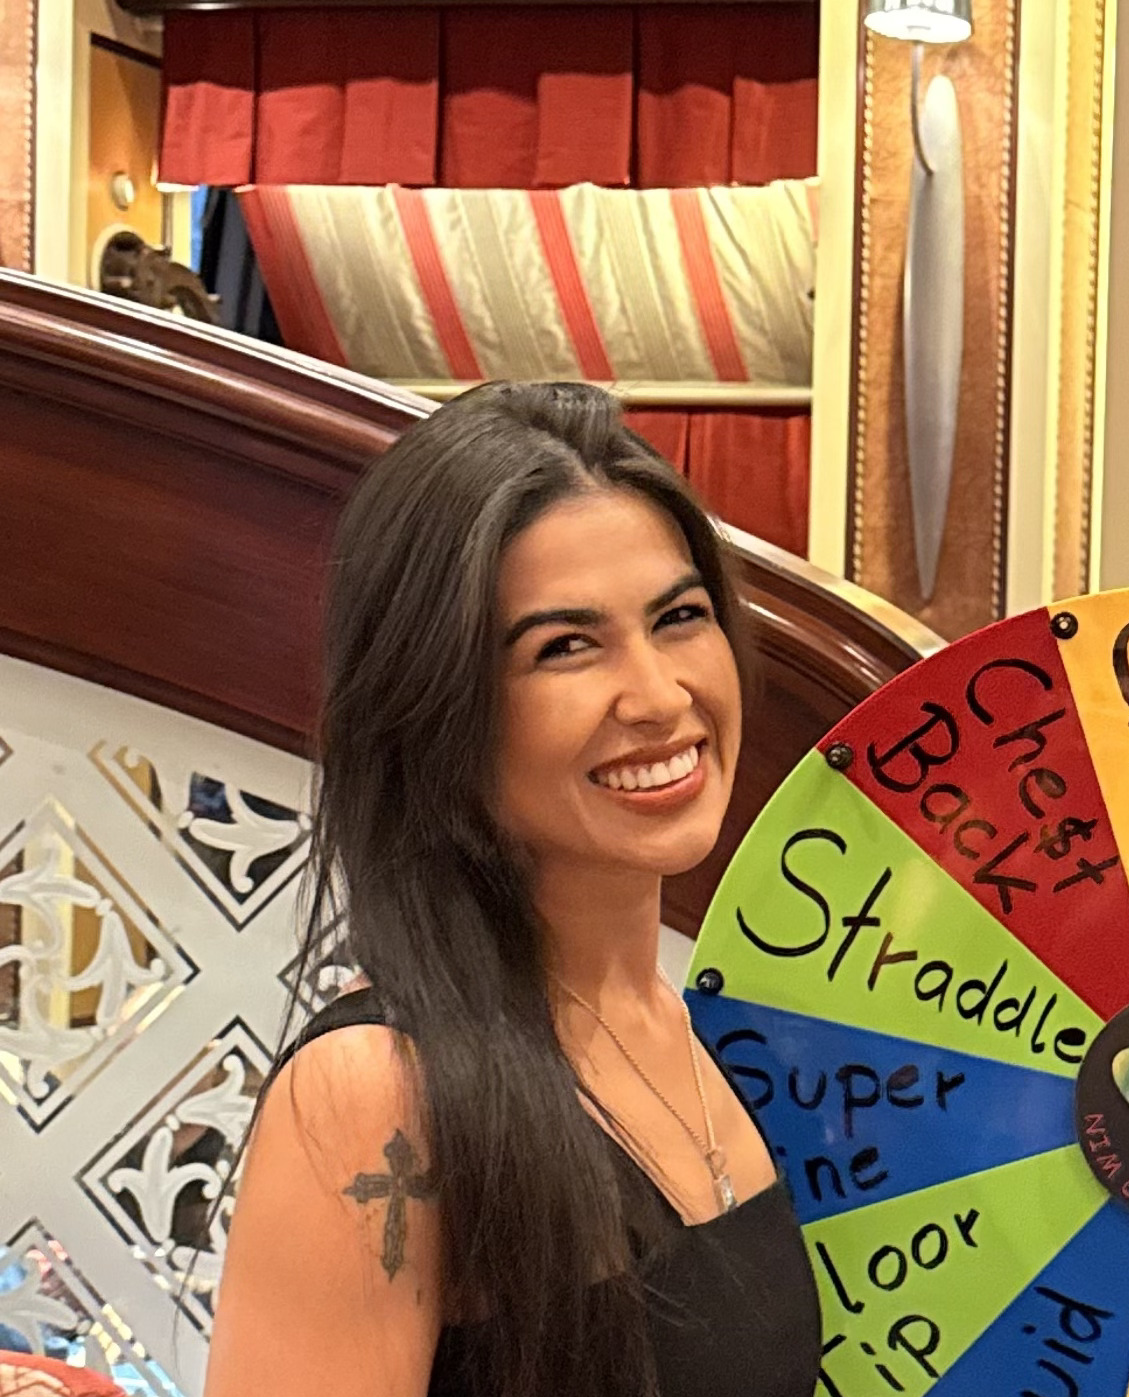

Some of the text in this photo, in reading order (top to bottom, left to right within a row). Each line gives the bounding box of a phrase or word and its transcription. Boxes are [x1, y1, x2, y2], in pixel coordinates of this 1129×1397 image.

[866, 700, 1037, 915] Back
[736, 827, 1087, 1065] Straddle
[714, 1028, 966, 1139] Super
[777, 1145, 890, 1203] ne
[1083, 1112, 1123, 1180] WIN
[814, 1207, 982, 1316] loor
